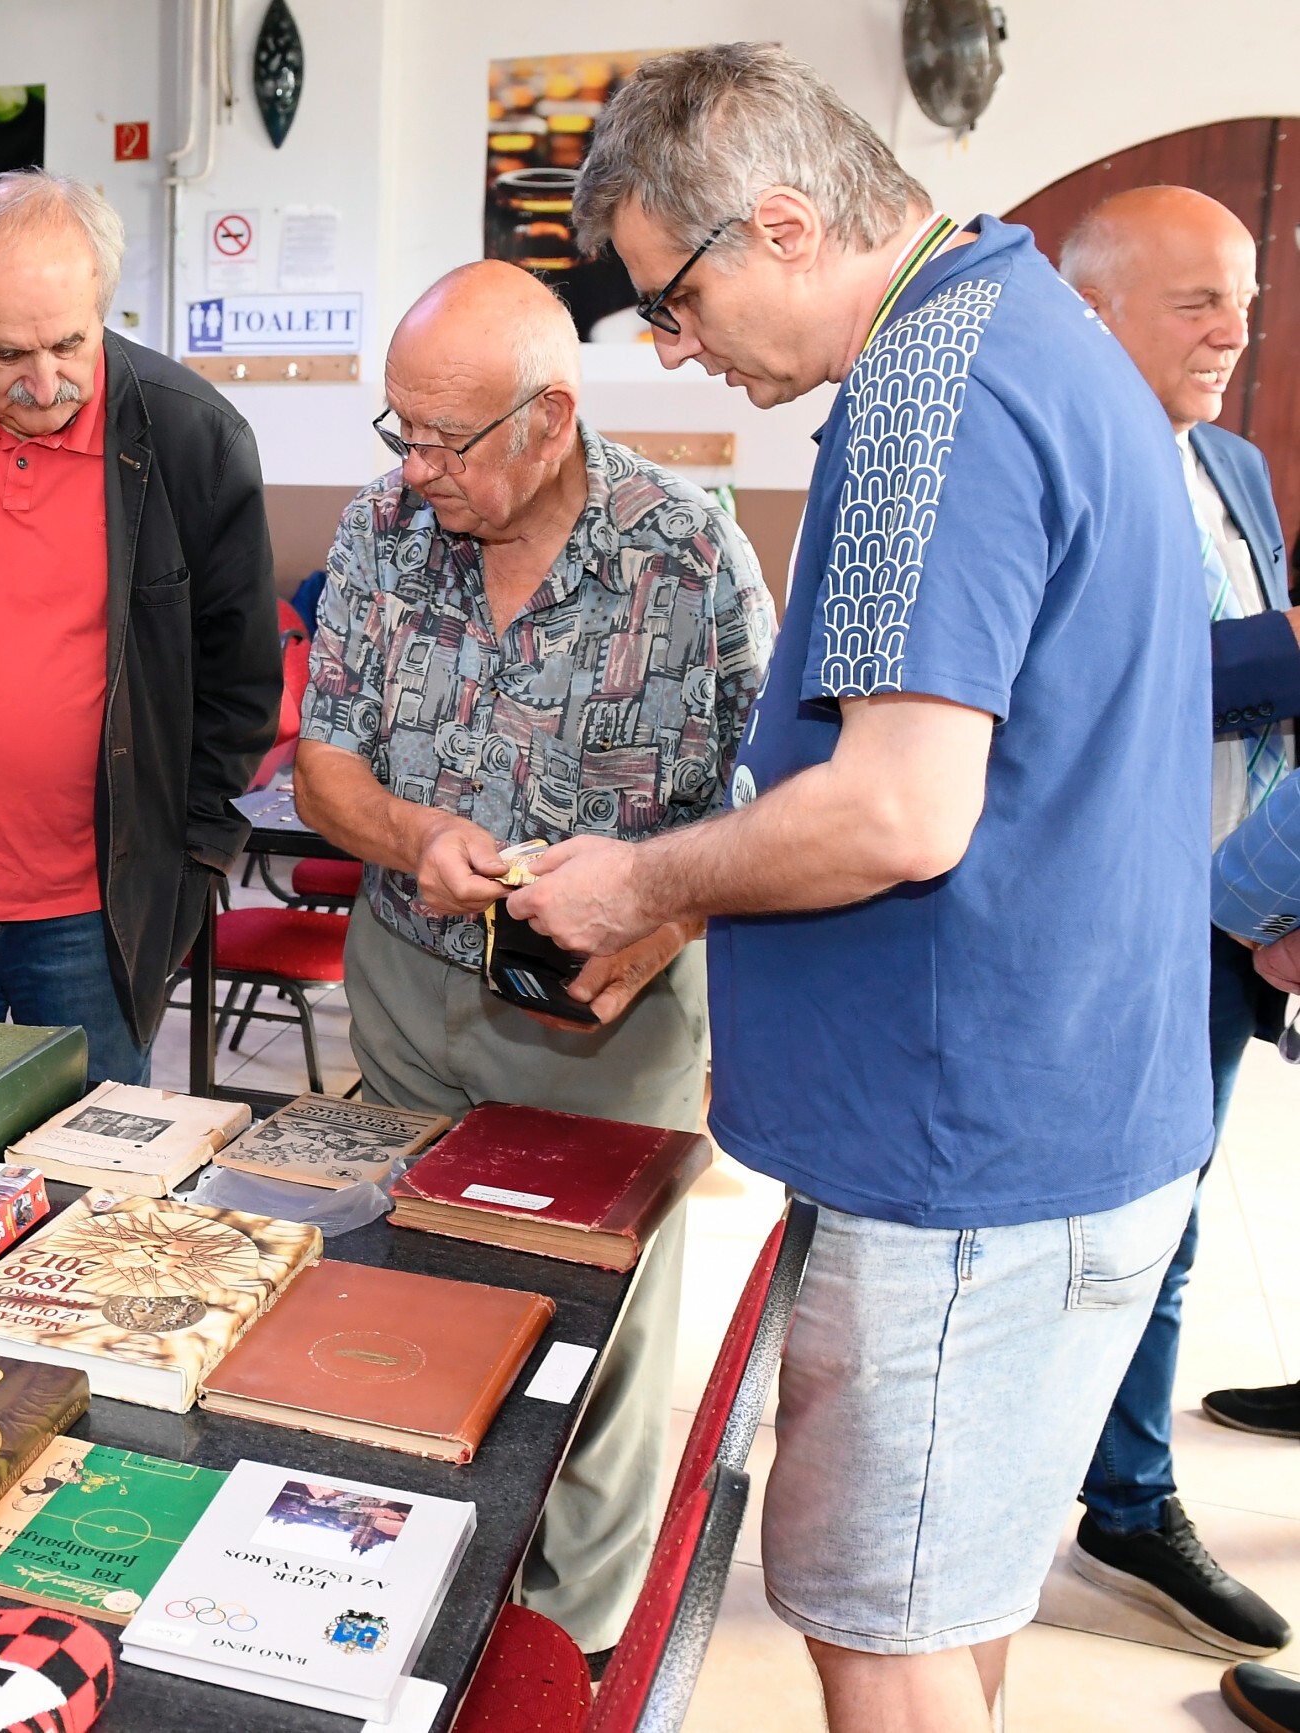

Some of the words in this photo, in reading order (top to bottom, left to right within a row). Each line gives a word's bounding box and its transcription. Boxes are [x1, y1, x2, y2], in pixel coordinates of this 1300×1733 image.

[228, 310, 356, 332] TOALETT
[18, 1249, 104, 1277] 2012
[2, 1266, 81, 1294] 1896
[59, 1311, 90, 1323] AZ
[51, 1551, 61, 1559] a
[223, 1547, 296, 1573] VÁROS
[92, 1567, 125, 1584] Fél
[272, 1570, 328, 1590] EGER
[297, 1563, 354, 1586] ÚSZÓ
[360, 1577, 391, 1591] AZ
[211, 1637, 258, 1655] JENŐ
[259, 1647, 309, 1666] BAKÓ
